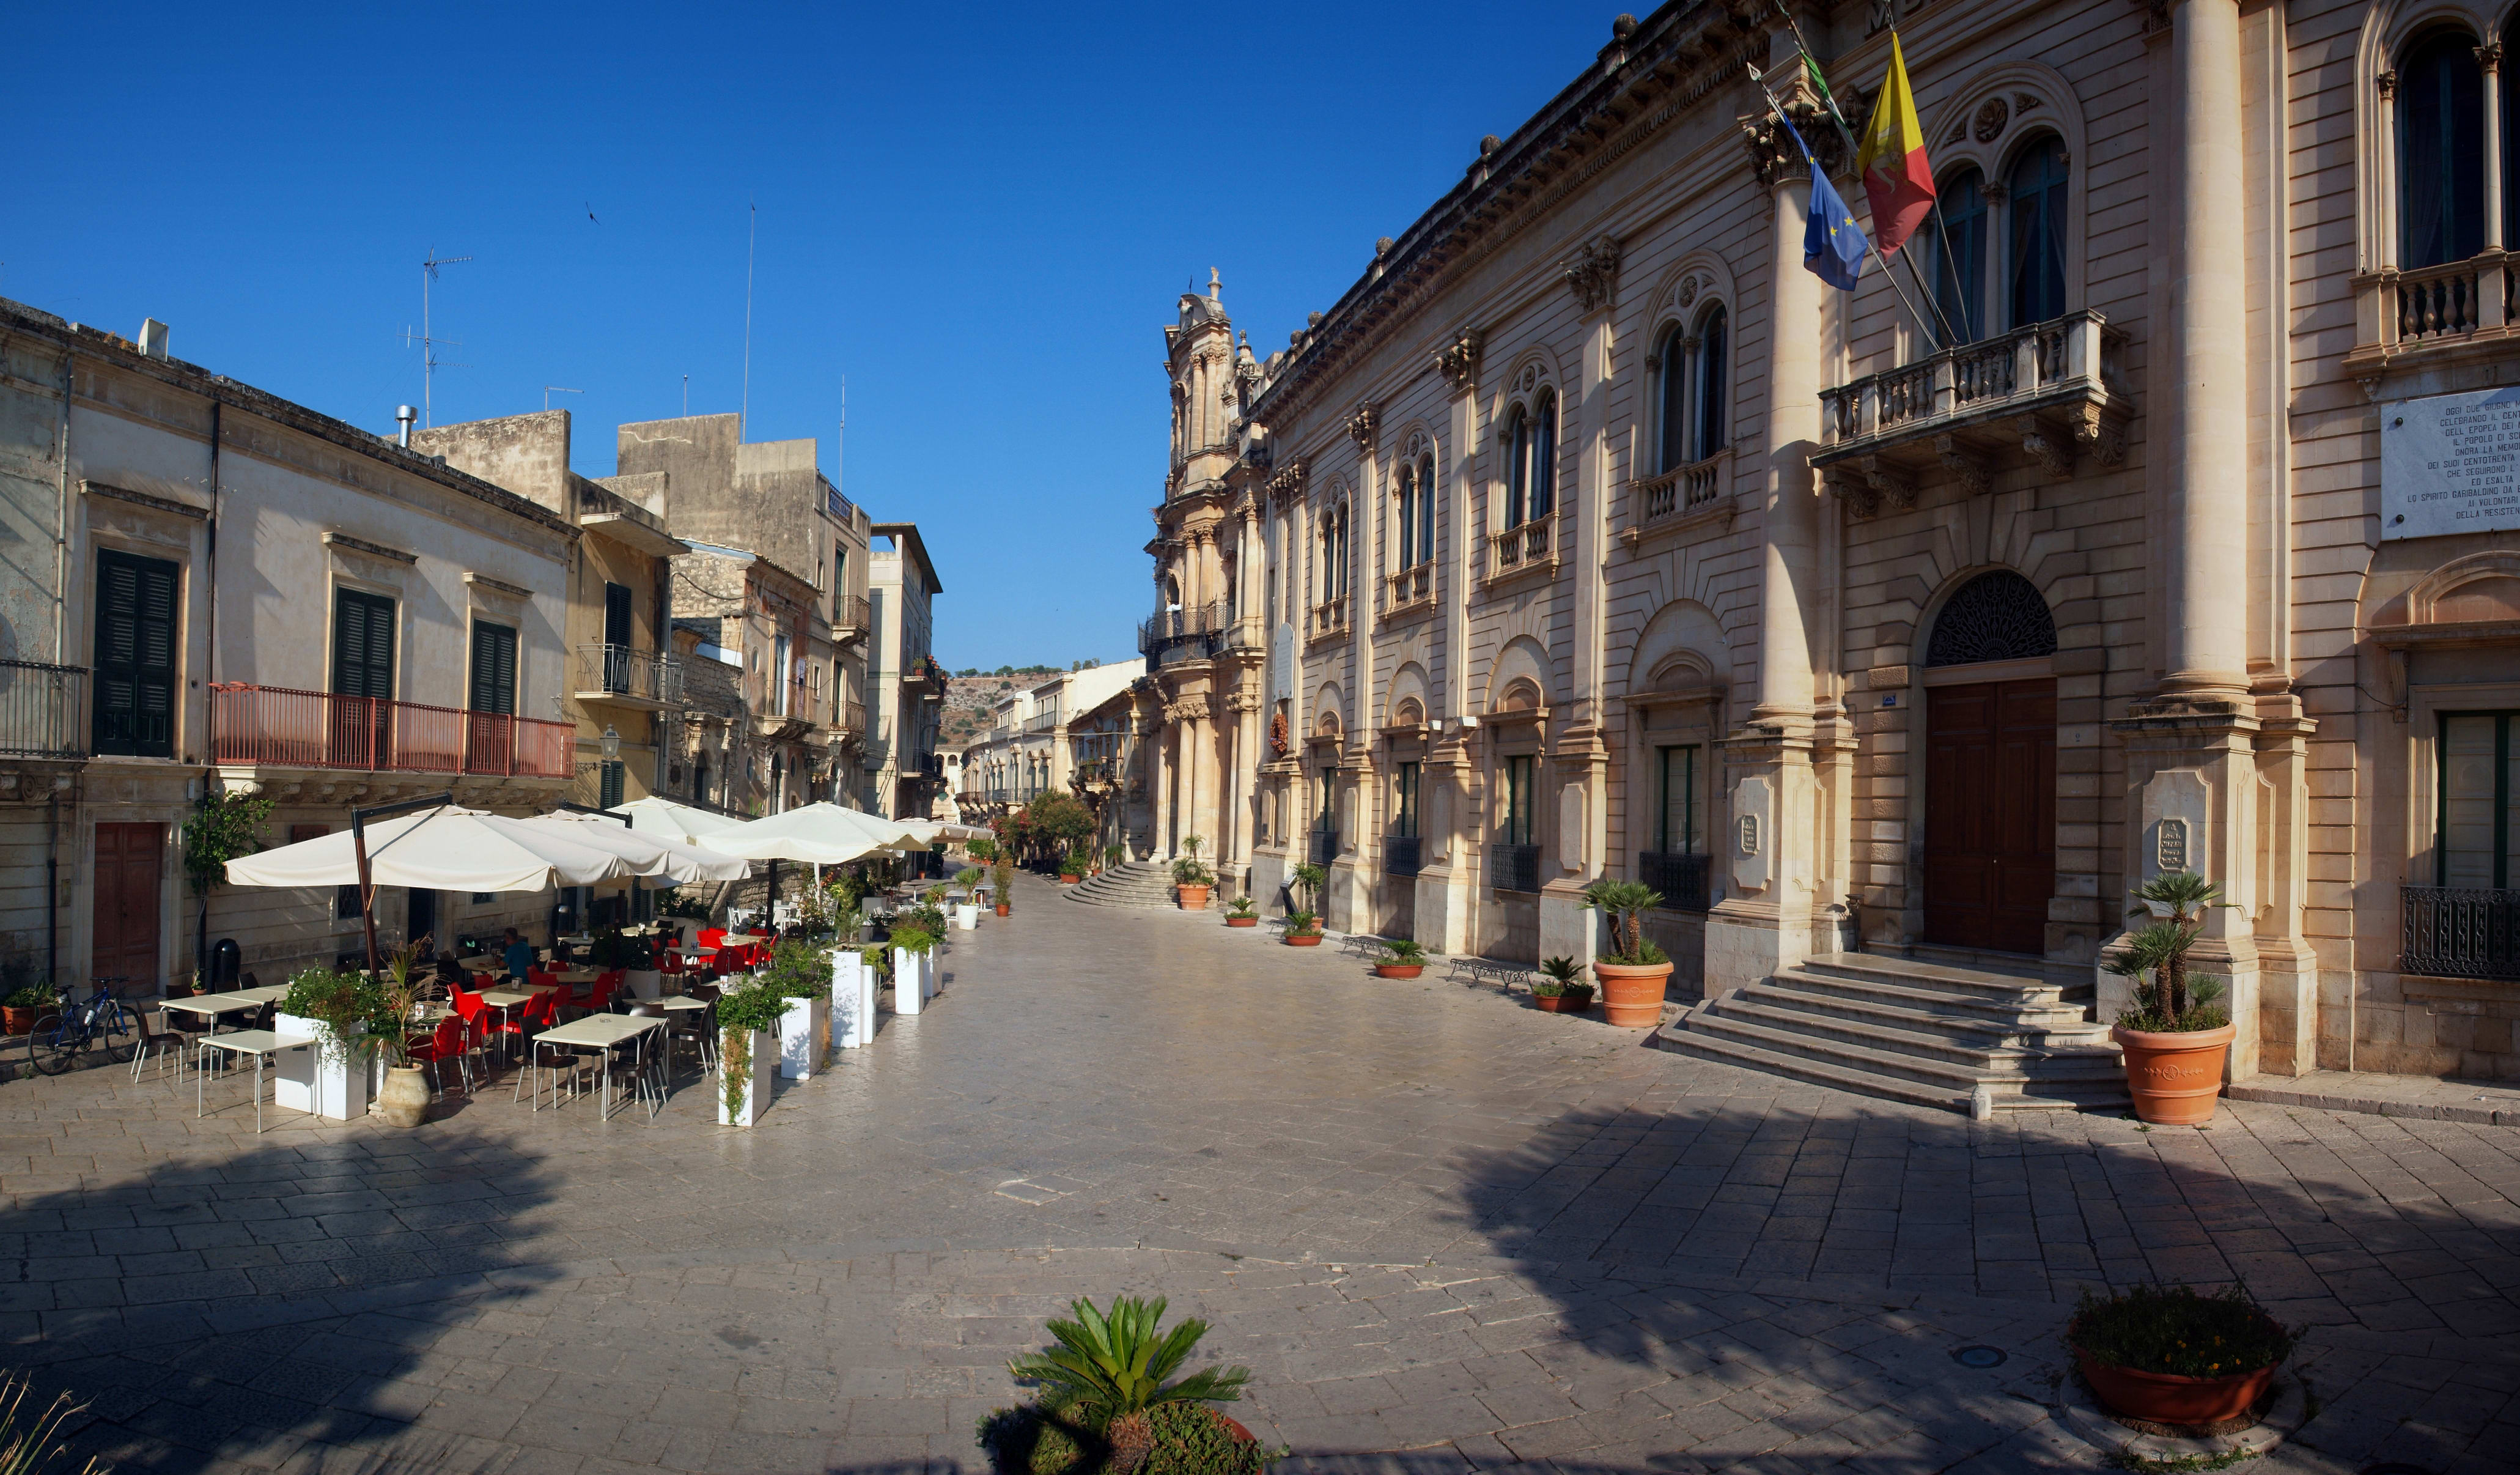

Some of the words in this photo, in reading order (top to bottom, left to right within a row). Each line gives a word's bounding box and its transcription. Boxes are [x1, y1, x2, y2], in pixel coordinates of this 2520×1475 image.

[2446, 407, 2461, 415] OGGI
[2485, 401, 2510, 410] GIUGNO
[2440, 415, 2486, 426] CELEBRANDO
[2469, 424, 2497, 434] EPOPEA
[2464, 435, 2492, 445] POPOLO
[2455, 447, 2478, 456] ONORA
[2444, 459, 2459, 468] SUOI
[2464, 454, 2515, 465] CENTOTRENTA
[2466, 465, 2505, 476] SEGUIRONO
[2486, 475, 2513, 485] ESALTA
[2421, 492, 2448, 501] SPIRITO
[2452, 487, 2499, 498] GARIBALDINO
[2479, 496, 2518, 507] VOLONTARI
[2456, 511, 2480, 519] DELLA
